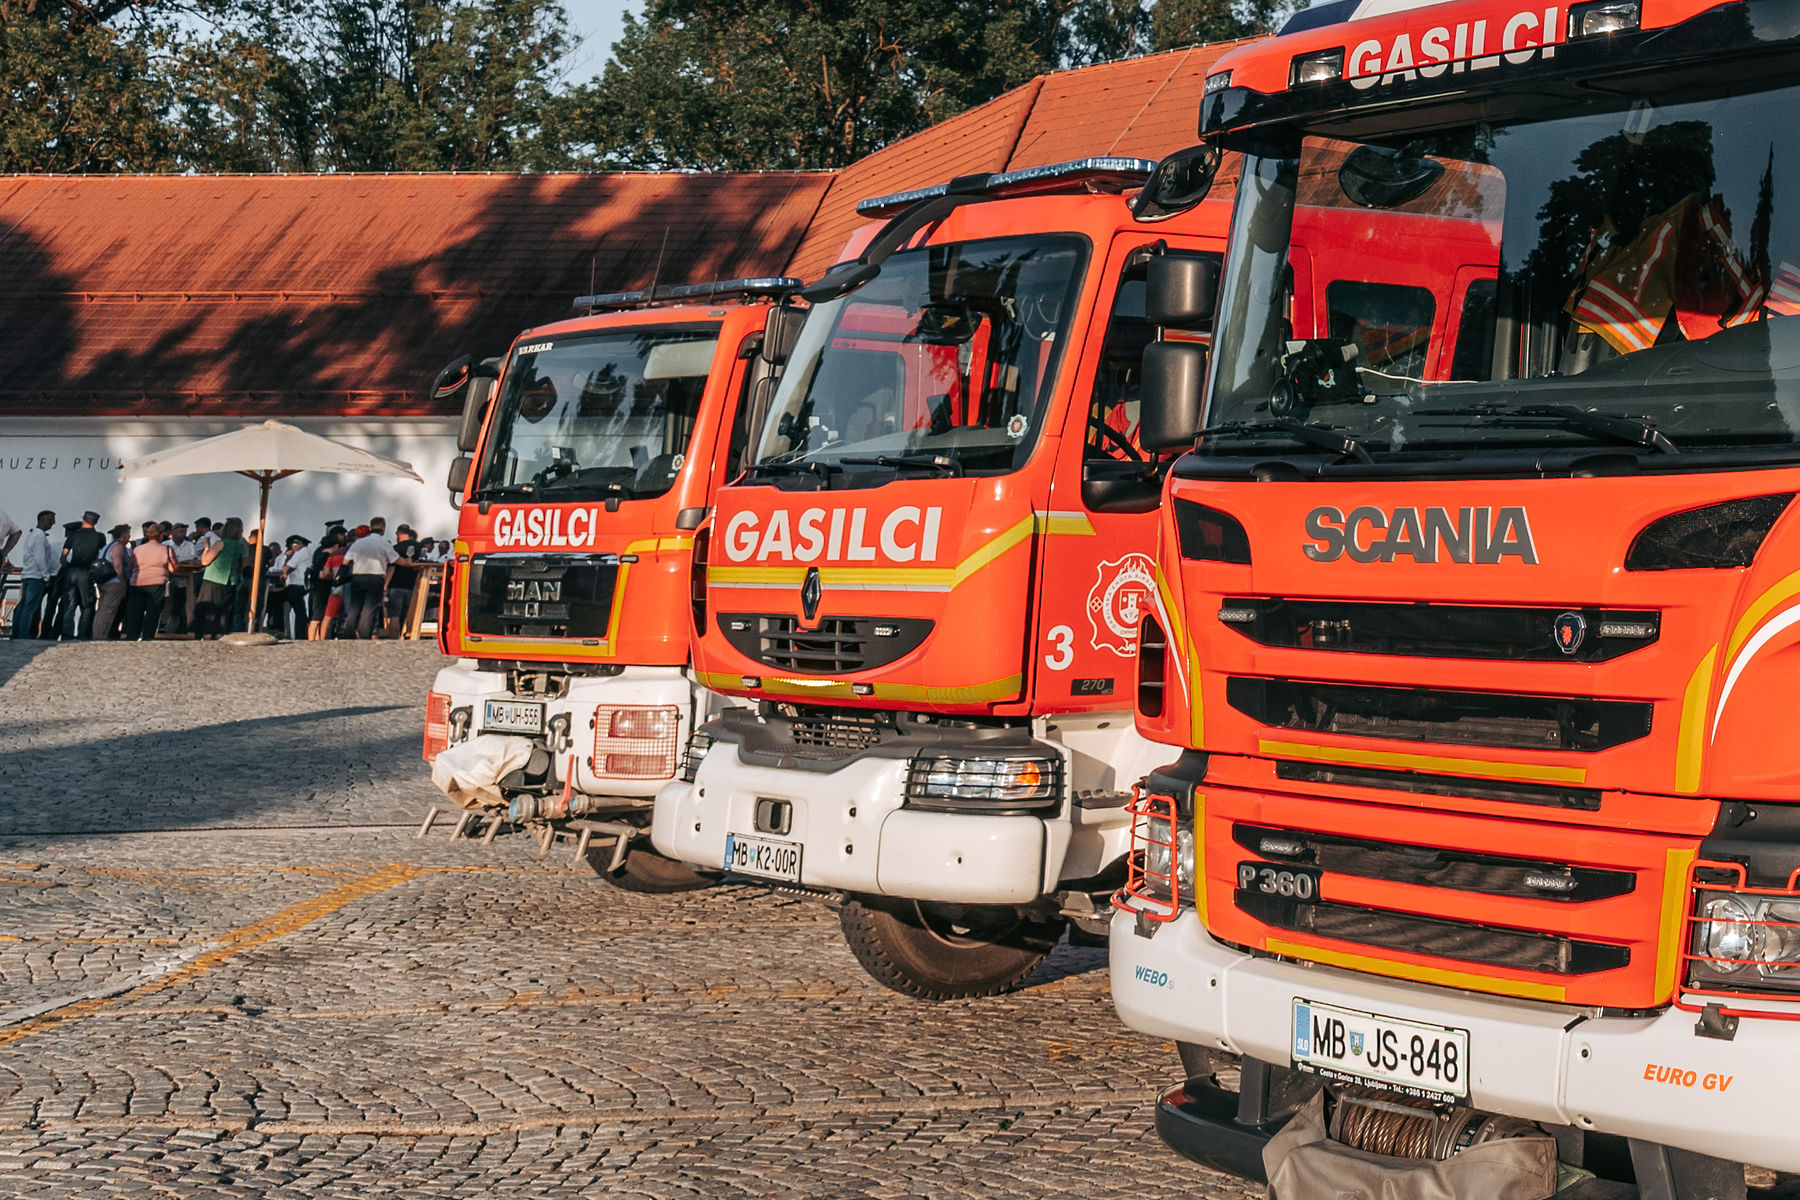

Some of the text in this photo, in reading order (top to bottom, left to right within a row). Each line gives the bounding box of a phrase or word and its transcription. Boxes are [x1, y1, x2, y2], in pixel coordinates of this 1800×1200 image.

[1349, 7, 1558, 89] GASILCI
[0, 457, 59, 469] UZEJ
[494, 508, 598, 547] GASILCI
[725, 506, 942, 562] GASILCI
[1302, 506, 1540, 564] SCANIA
[507, 581, 561, 601] MAN
[1045, 624, 1074, 671] 3
[1081, 680, 1105, 691] 270
[493, 706, 504, 723] MB
[732, 840, 747, 866] MB
[1239, 865, 1312, 899] P 360
[1297, 1015, 1458, 1083] SLO MB JS-848
[1643, 1063, 1733, 1091] EURO GV
[1426, 1091, 1441, 1101] 2427
